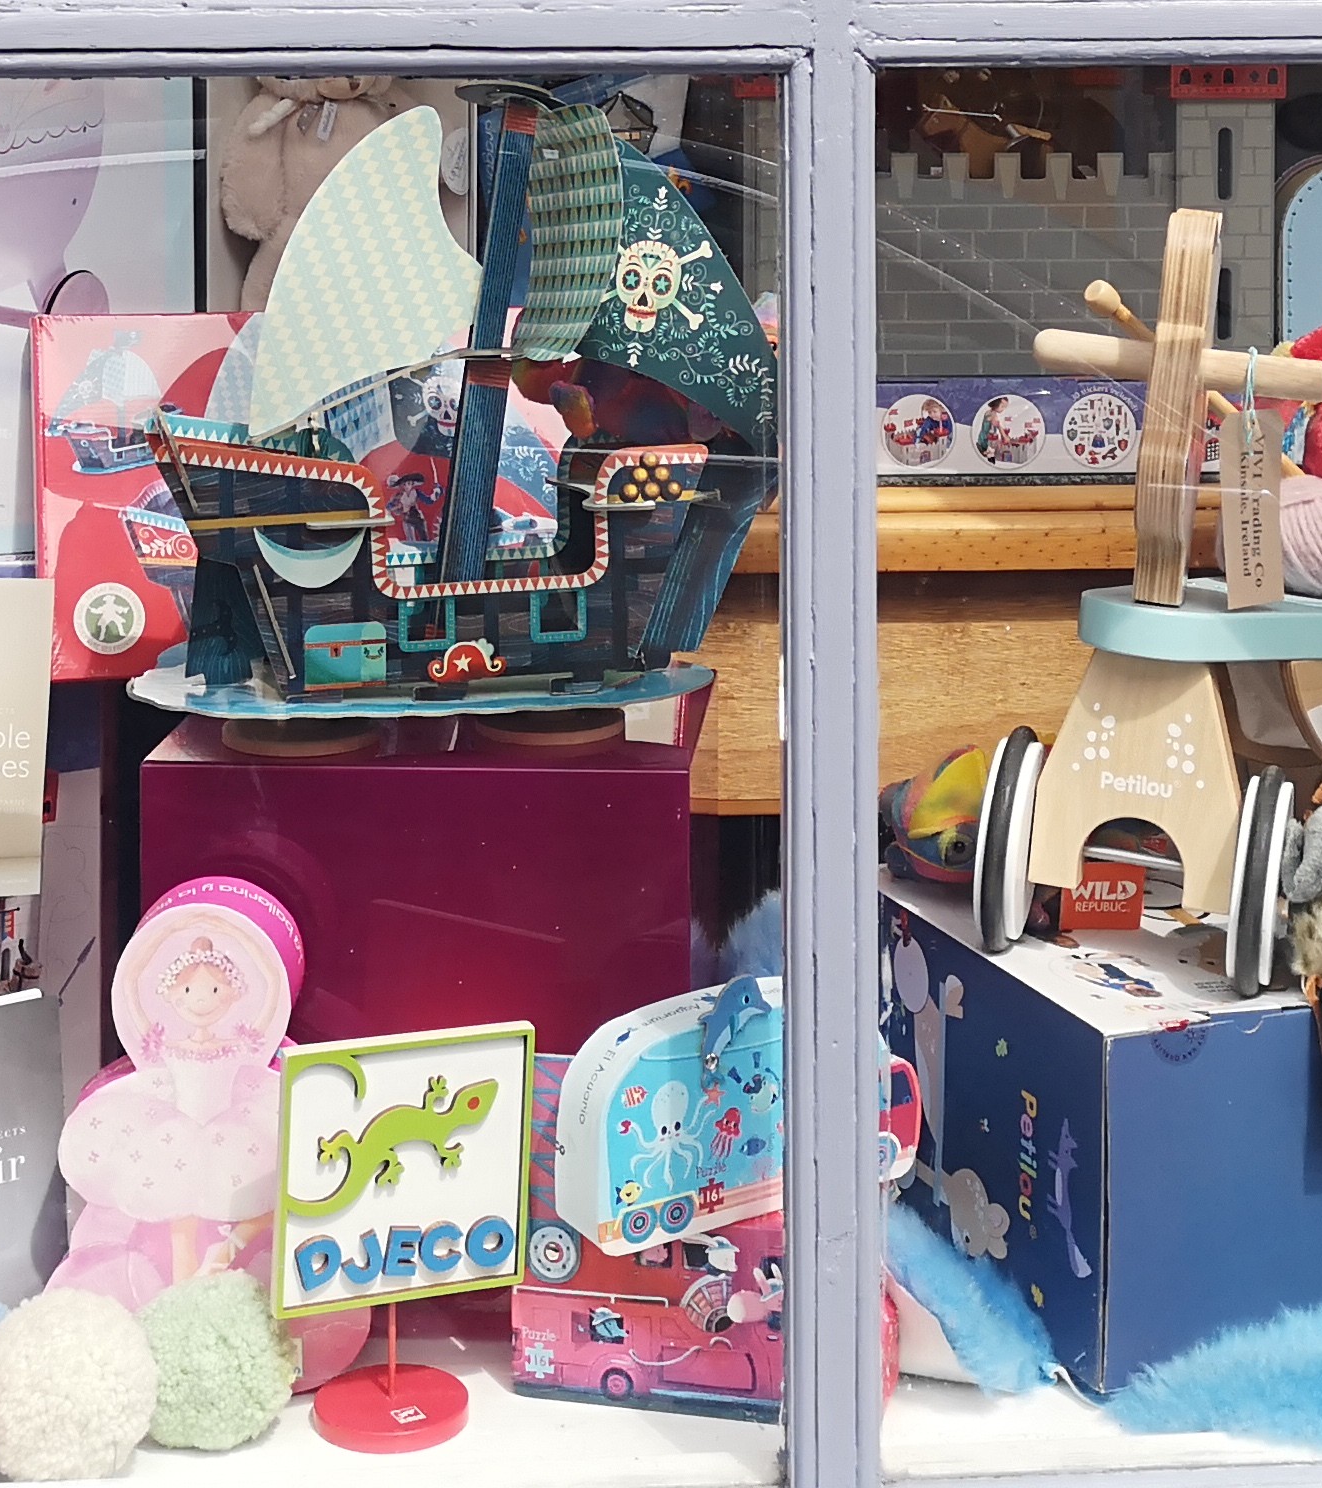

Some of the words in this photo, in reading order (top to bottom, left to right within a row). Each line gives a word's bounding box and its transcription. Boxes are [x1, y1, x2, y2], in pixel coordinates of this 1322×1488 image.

[1252, 434, 1265, 480] VIVI
[1251, 484, 1265, 557] rading
[1240, 520, 1252, 577] Ireland
[1254, 562, 1265, 588] Co
[1101, 771, 1173, 799] Petilou
[1070, 880, 1138, 901] WILD
[218, 883, 294, 939] bailarina
[1075, 901, 1128, 913] REPUBLIC
[578, 1063, 603, 1125] Acuario
[1018, 1089, 1038, 1221] Petilou
[695, 1163, 727, 1179] Puzzle
[706, 1191, 719, 1204] 16
[293, 1215, 515, 1292] DJECO
[522, 1326, 557, 1343] Puzzle
[531, 1354, 547, 1367] 16
